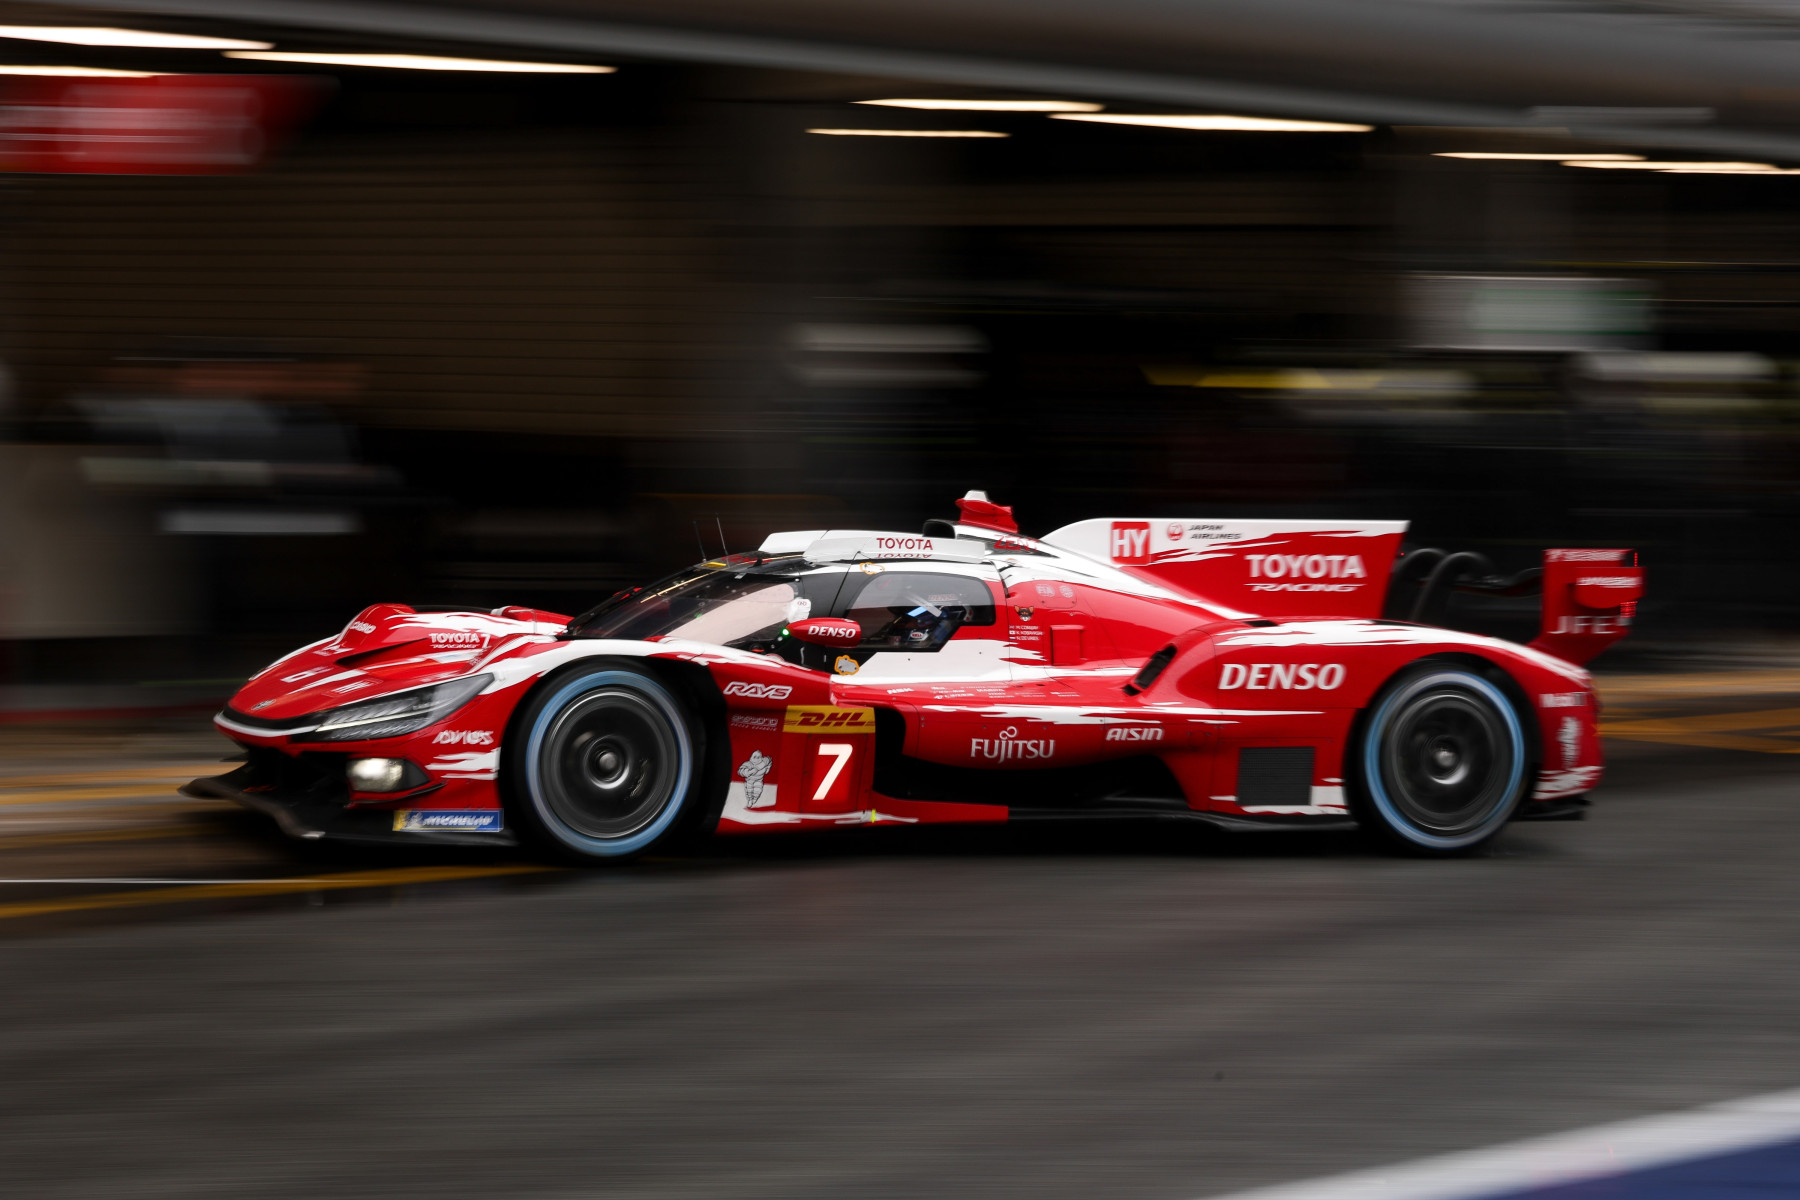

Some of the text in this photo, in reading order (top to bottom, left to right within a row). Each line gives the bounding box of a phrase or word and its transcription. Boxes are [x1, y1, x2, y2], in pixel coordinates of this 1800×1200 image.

[877, 538, 933, 550] TOYOTA
[1112, 528, 1149, 557] HY
[1245, 554, 1366, 578] TOYOTA
[429, 633, 480, 643] TOYOTA
[808, 625, 856, 638] DENSO
[480, 633, 491, 649] 7
[1218, 664, 1347, 690] DENSO
[723, 681, 793, 699] RAYS
[799, 712, 867, 727] DHL
[970, 727, 1055, 764] FUJITSU
[812, 743, 854, 801] 7
[423, 815, 494, 826] MICHELIN
